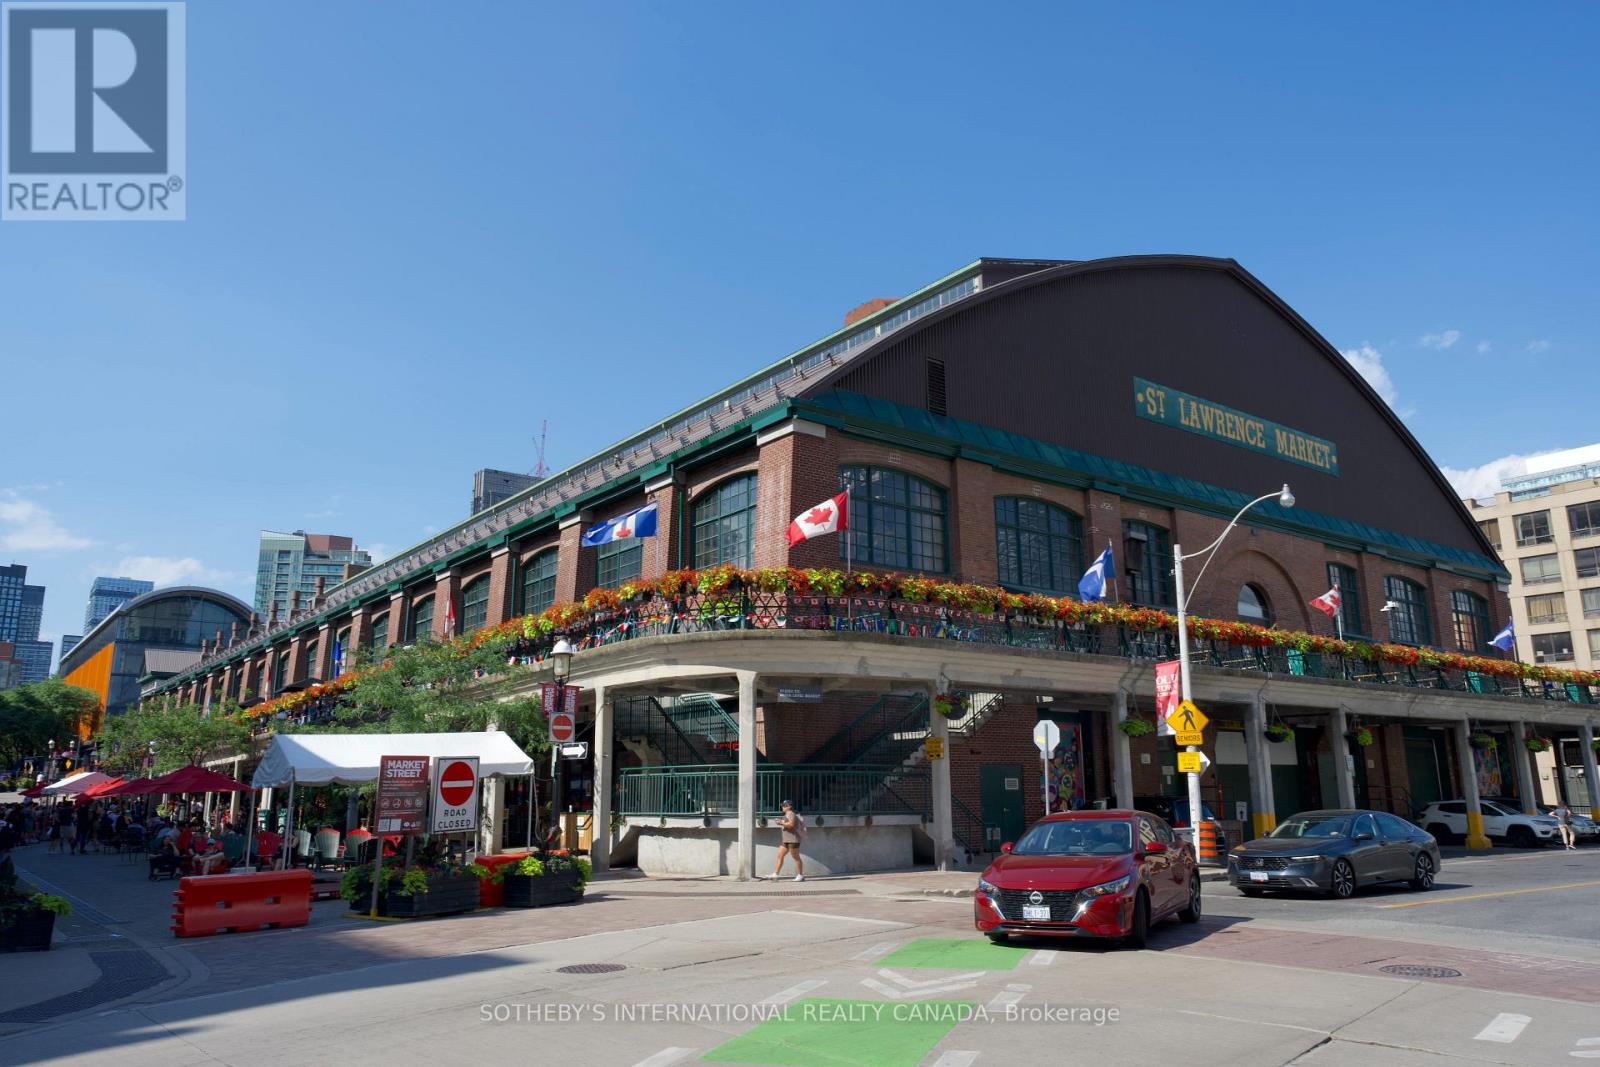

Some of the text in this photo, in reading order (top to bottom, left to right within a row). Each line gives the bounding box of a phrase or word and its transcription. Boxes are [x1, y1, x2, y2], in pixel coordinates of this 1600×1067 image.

[1179, 397, 1265, 448] LAWRENCE
[1275, 429, 1330, 469] MARKET
[1177, 734, 1201, 742] SENIORS
[388, 760, 427, 769] MARKET
[386, 769, 422, 778] STREET
[443, 808, 467, 817] ROAD
[438, 819, 471, 829] CLOSED
